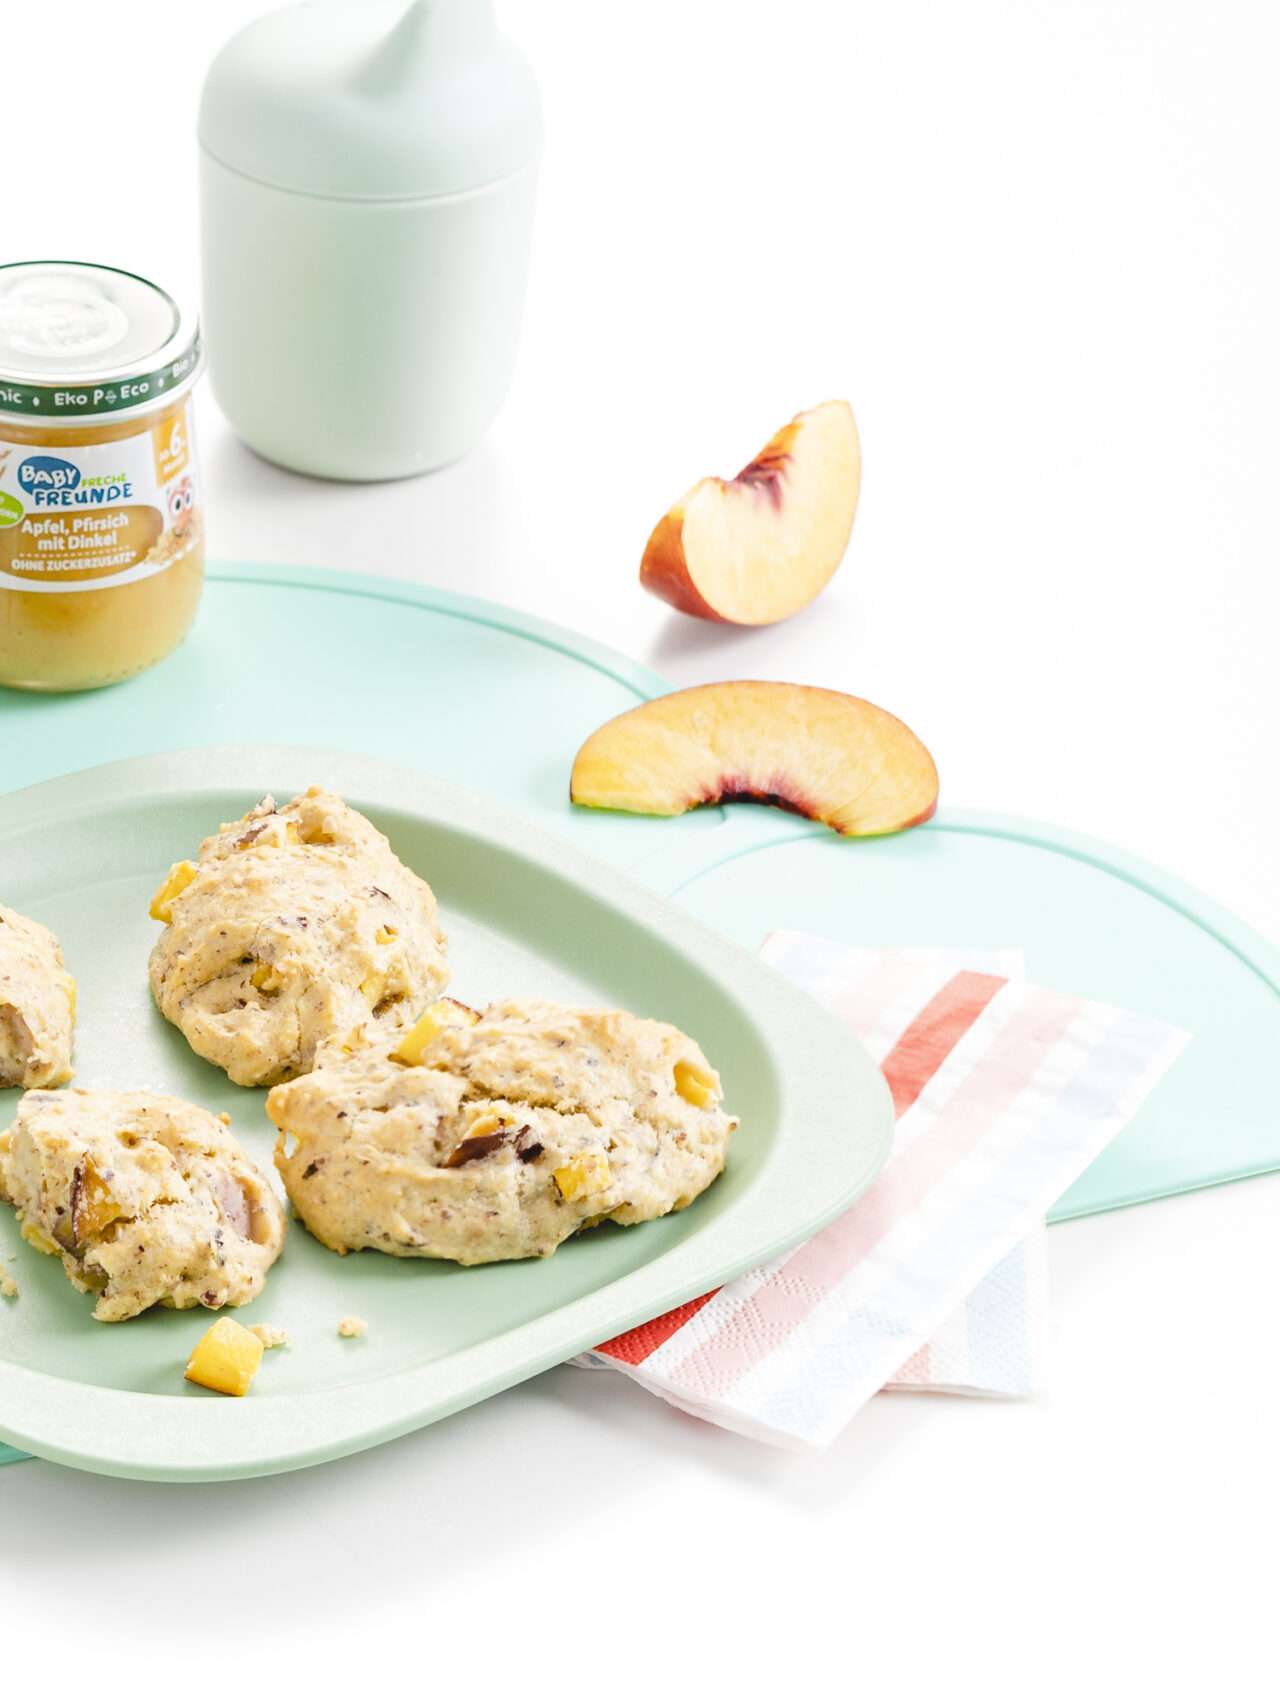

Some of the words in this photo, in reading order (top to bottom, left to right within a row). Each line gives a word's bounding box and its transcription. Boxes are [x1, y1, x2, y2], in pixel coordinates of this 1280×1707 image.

[54, 391, 88, 407] Eko
[120, 381, 150, 400] Eco
[22, 464, 77, 489] BABY
[81, 472, 128, 488] FRECHE
[33, 482, 134, 507] FREUNDE
[21, 518, 70, 538] Apfel,
[73, 512, 129, 533] Pfirsich
[37, 535, 66, 552] mit
[67, 529, 118, 550] Dinkel
[10, 557, 44, 572] OHNE
